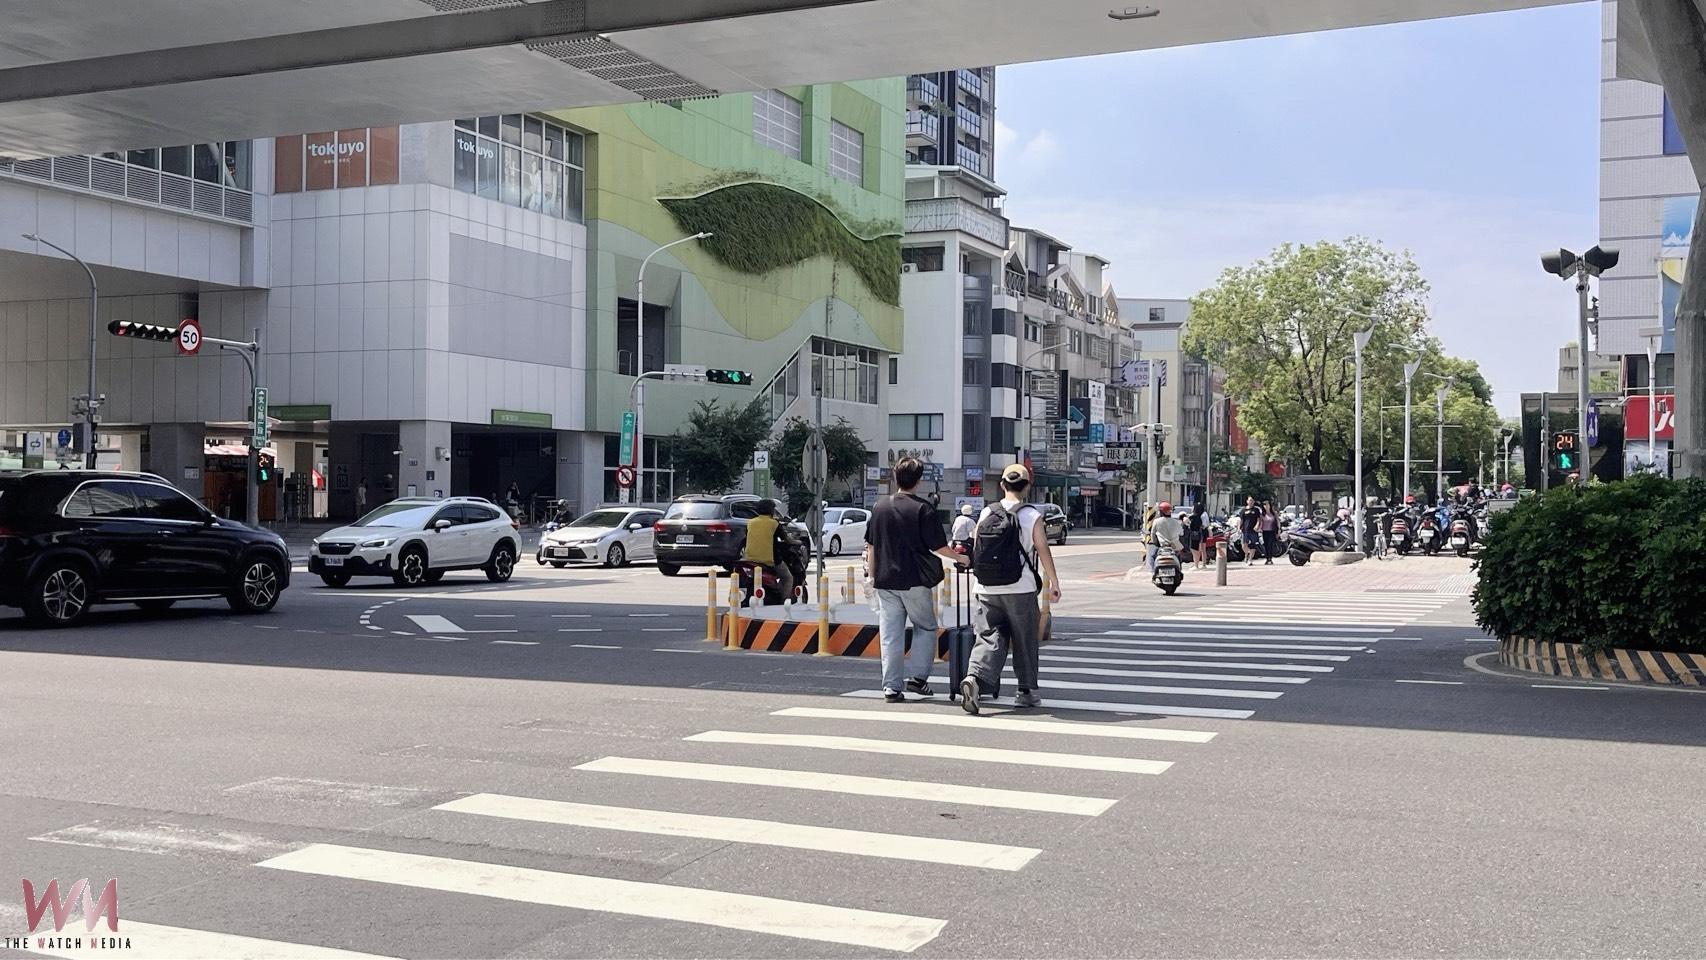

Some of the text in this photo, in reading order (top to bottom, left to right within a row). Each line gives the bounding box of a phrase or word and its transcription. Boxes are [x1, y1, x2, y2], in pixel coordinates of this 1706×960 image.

[309, 141, 364, 156] tokuyo
[458, 138, 494, 158] tokuyo
[182, 331, 198, 344] 50
[1556, 435, 1573, 449] 24
[1106, 448, 1138, 460] 眼鏡
